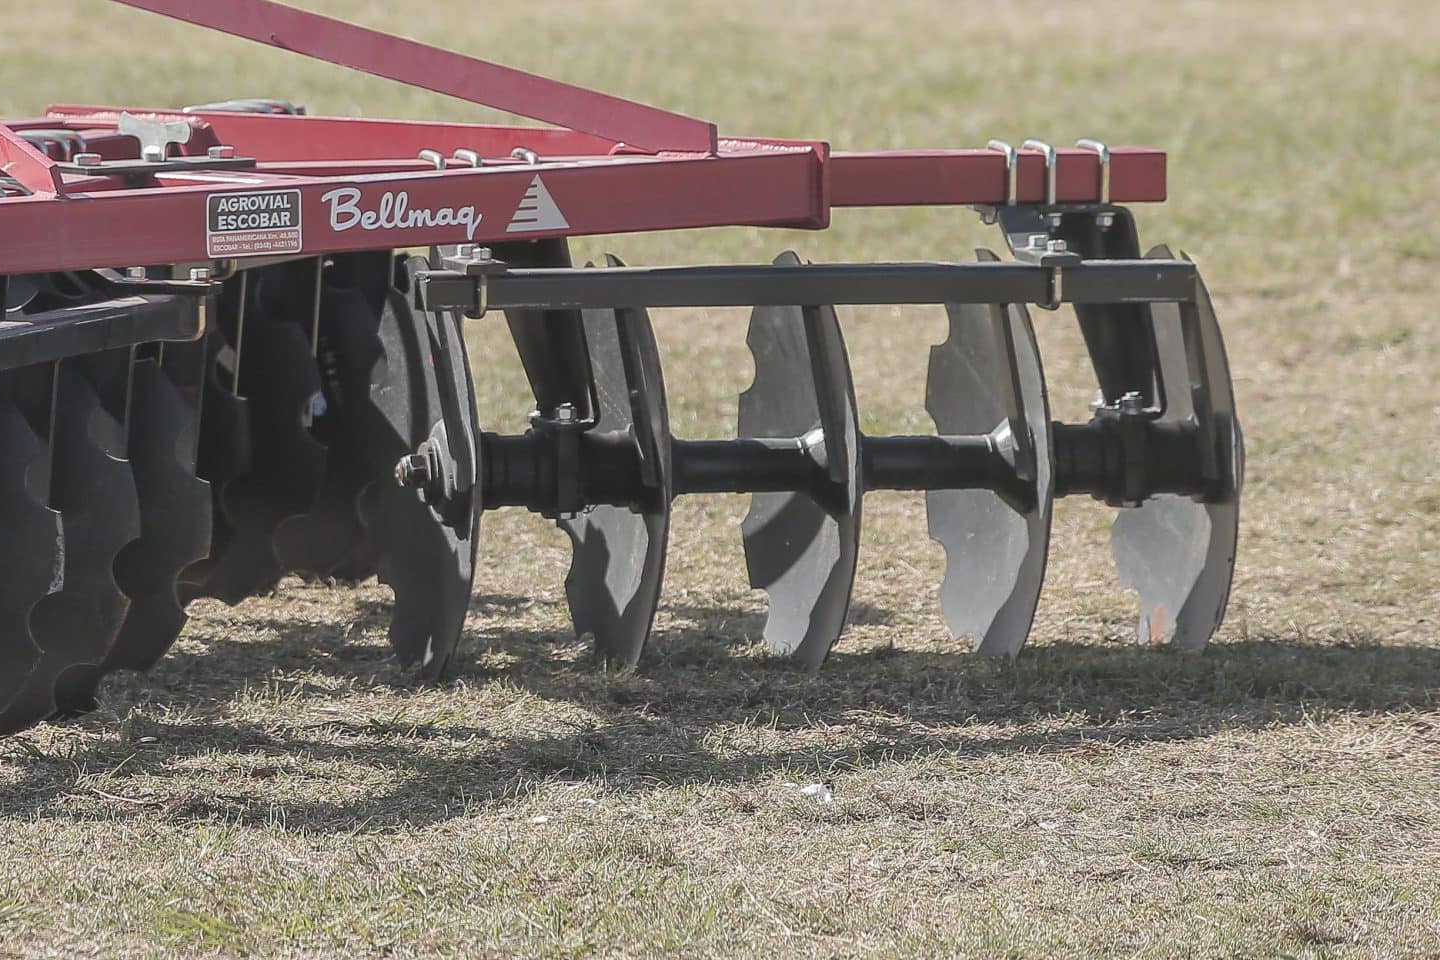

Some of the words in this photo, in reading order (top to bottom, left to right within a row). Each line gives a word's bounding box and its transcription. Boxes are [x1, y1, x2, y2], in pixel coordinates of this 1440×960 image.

[217, 194, 291, 212] AGROVIAL
[218, 211, 291, 230] ESCOBAR
[321, 187, 482, 240] Bellmaq
